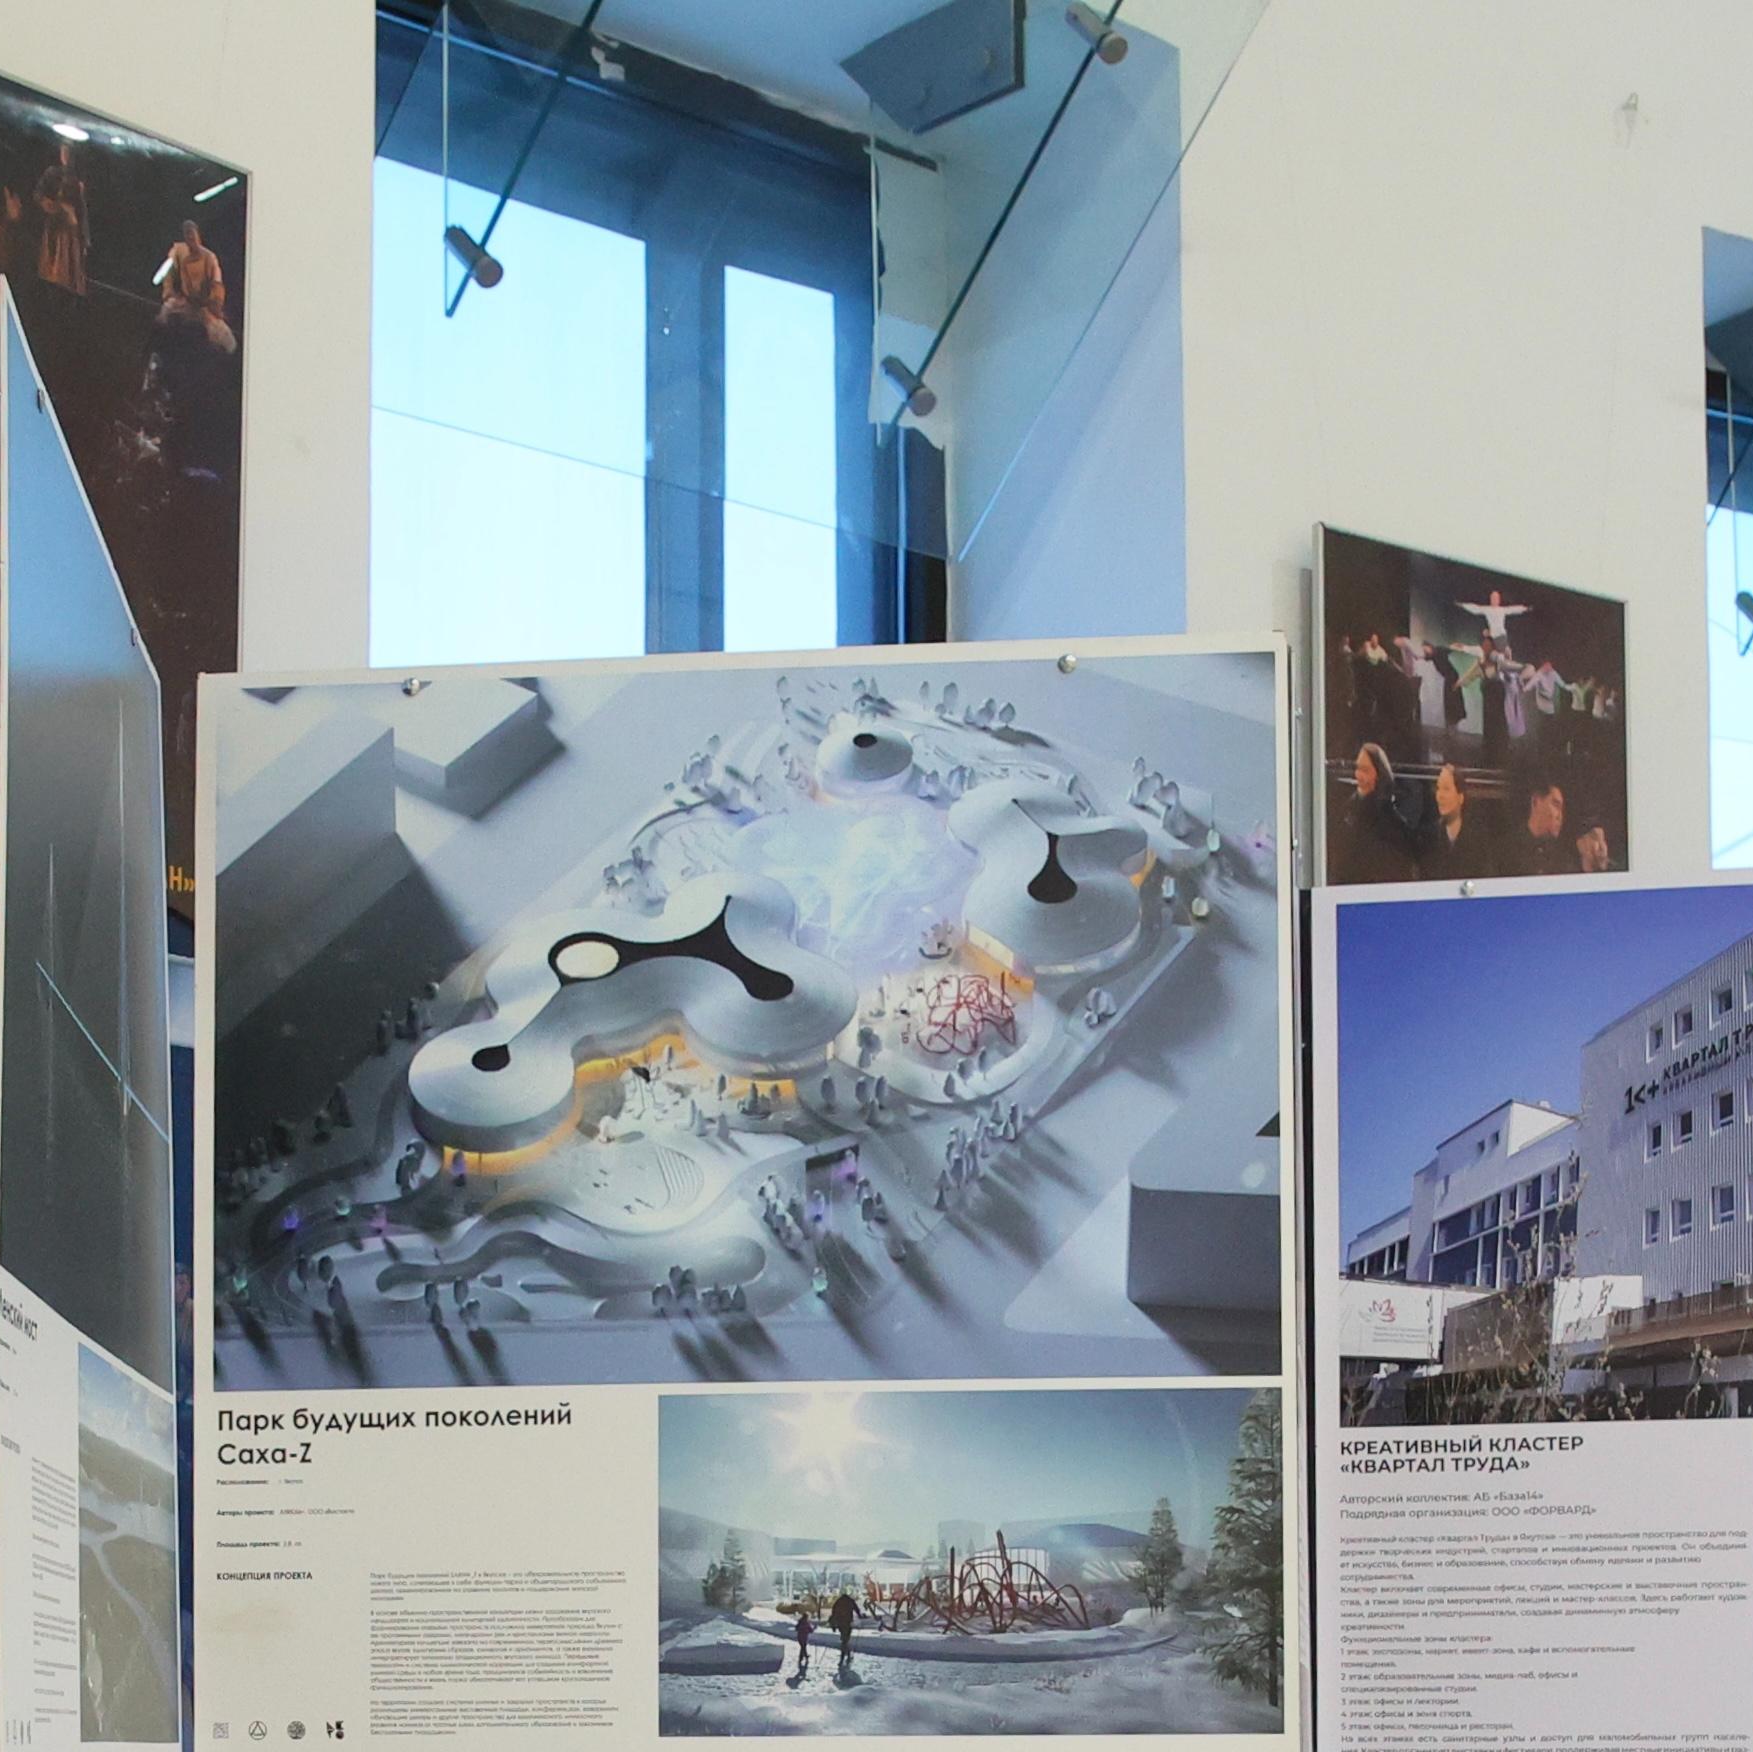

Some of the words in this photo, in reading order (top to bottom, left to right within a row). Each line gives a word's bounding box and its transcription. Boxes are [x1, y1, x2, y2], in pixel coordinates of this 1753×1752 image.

[218, 1409, 284, 1436] Парк
[292, 1406, 415, 1434] будущих
[425, 1402, 571, 1427] поколений
[217, 1442, 311, 1465] Саха-Z
[1340, 1435, 1481, 1455] КРЕАТИВНЫЙ
[1489, 1435, 1583, 1452] КЛАСТЕР
[1340, 1457, 1444, 1473] «КВАРТАЛ
[1450, 1456, 1530, 1473] ТРУДА»
[1338, 1493, 1403, 1505] Авторский
[1406, 1494, 1470, 1503] коллектив:
[1473, 1491, 1490, 1502] АБ
[1339, 1508, 1406, 1520] Подрядная
[1491, 1505, 1520, 1517] ООО
[216, 1571, 271, 1581] КОНЦЕПЦИЯ
[273, 1571, 312, 1580] ПРОЕКТА
